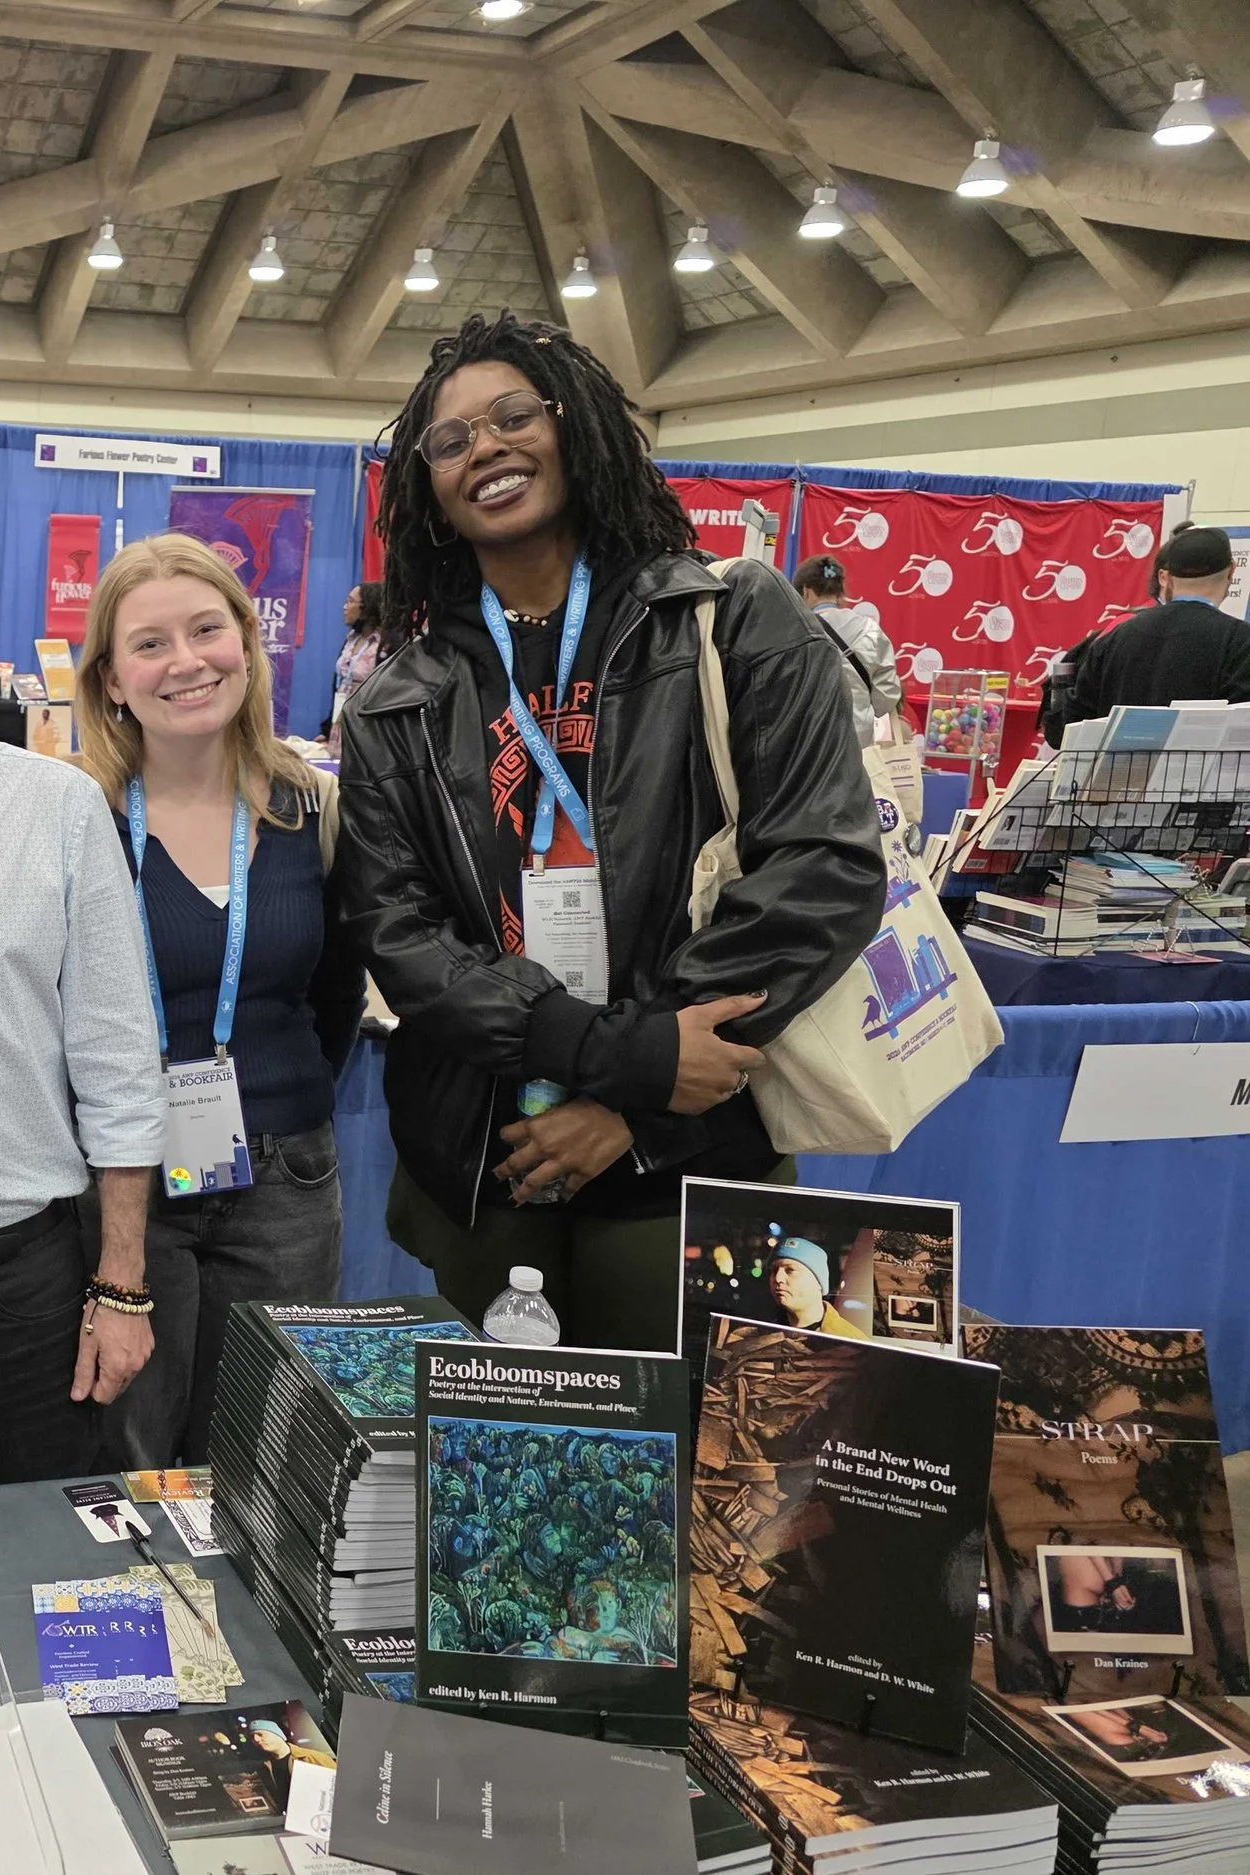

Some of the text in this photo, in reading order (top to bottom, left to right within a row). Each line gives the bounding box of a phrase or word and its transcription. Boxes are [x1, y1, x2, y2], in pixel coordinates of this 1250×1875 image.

[79, 449, 178, 464] Furious Flower Poetry Center
[560, 581, 585, 684] WRITERS & WRITING
[532, 736, 570, 798] PROGRAMS
[226, 802, 246, 985] ASSOCIATION OF WRITERS & WRITING
[180, 1072, 233, 1087] BOOKFAIR
[169, 1095, 221, 1108] Natalie Brault
[263, 1305, 404, 1317] Ecobloomspaces
[429, 1356, 620, 1390] Ecobloomspaces
[429, 1380, 456, 1390] Poetry
[468, 1382, 480, 1390] the
[482, 1382, 530, 1395] Intersection
[532, 1386, 542, 1397] of
[429, 1390, 454, 1400] Social
[456, 1392, 486, 1403] Identity
[488, 1396, 504, 1404] and
[507, 1396, 537, 1407] Nature,
[596, 1402, 612, 1412] and
[1040, 1421, 1153, 1442] STRAP
[822, 1440, 950, 1476] A Brand New Word
[1081, 1452, 1118, 1466] Poems
[816, 1455, 956, 1496] in the End Drops Out
[817, 1478, 947, 1513] Personal Stories of Mental Health
[840, 1494, 921, 1518] and Mental Wellness
[63, 1625, 98, 1635] WTR
[796, 1651, 935, 1694] Ken R. Harmon and D. W. White
[848, 1654, 882, 1670] edited by
[1094, 1657, 1148, 1670] Dan Kraines
[429, 1685, 556, 1704] edited by Ken R. Harmon
[379, 1750, 393, 1783] Silence
[379, 1783, 390, 1794] in
[482, 1808, 492, 1839] Hannah
